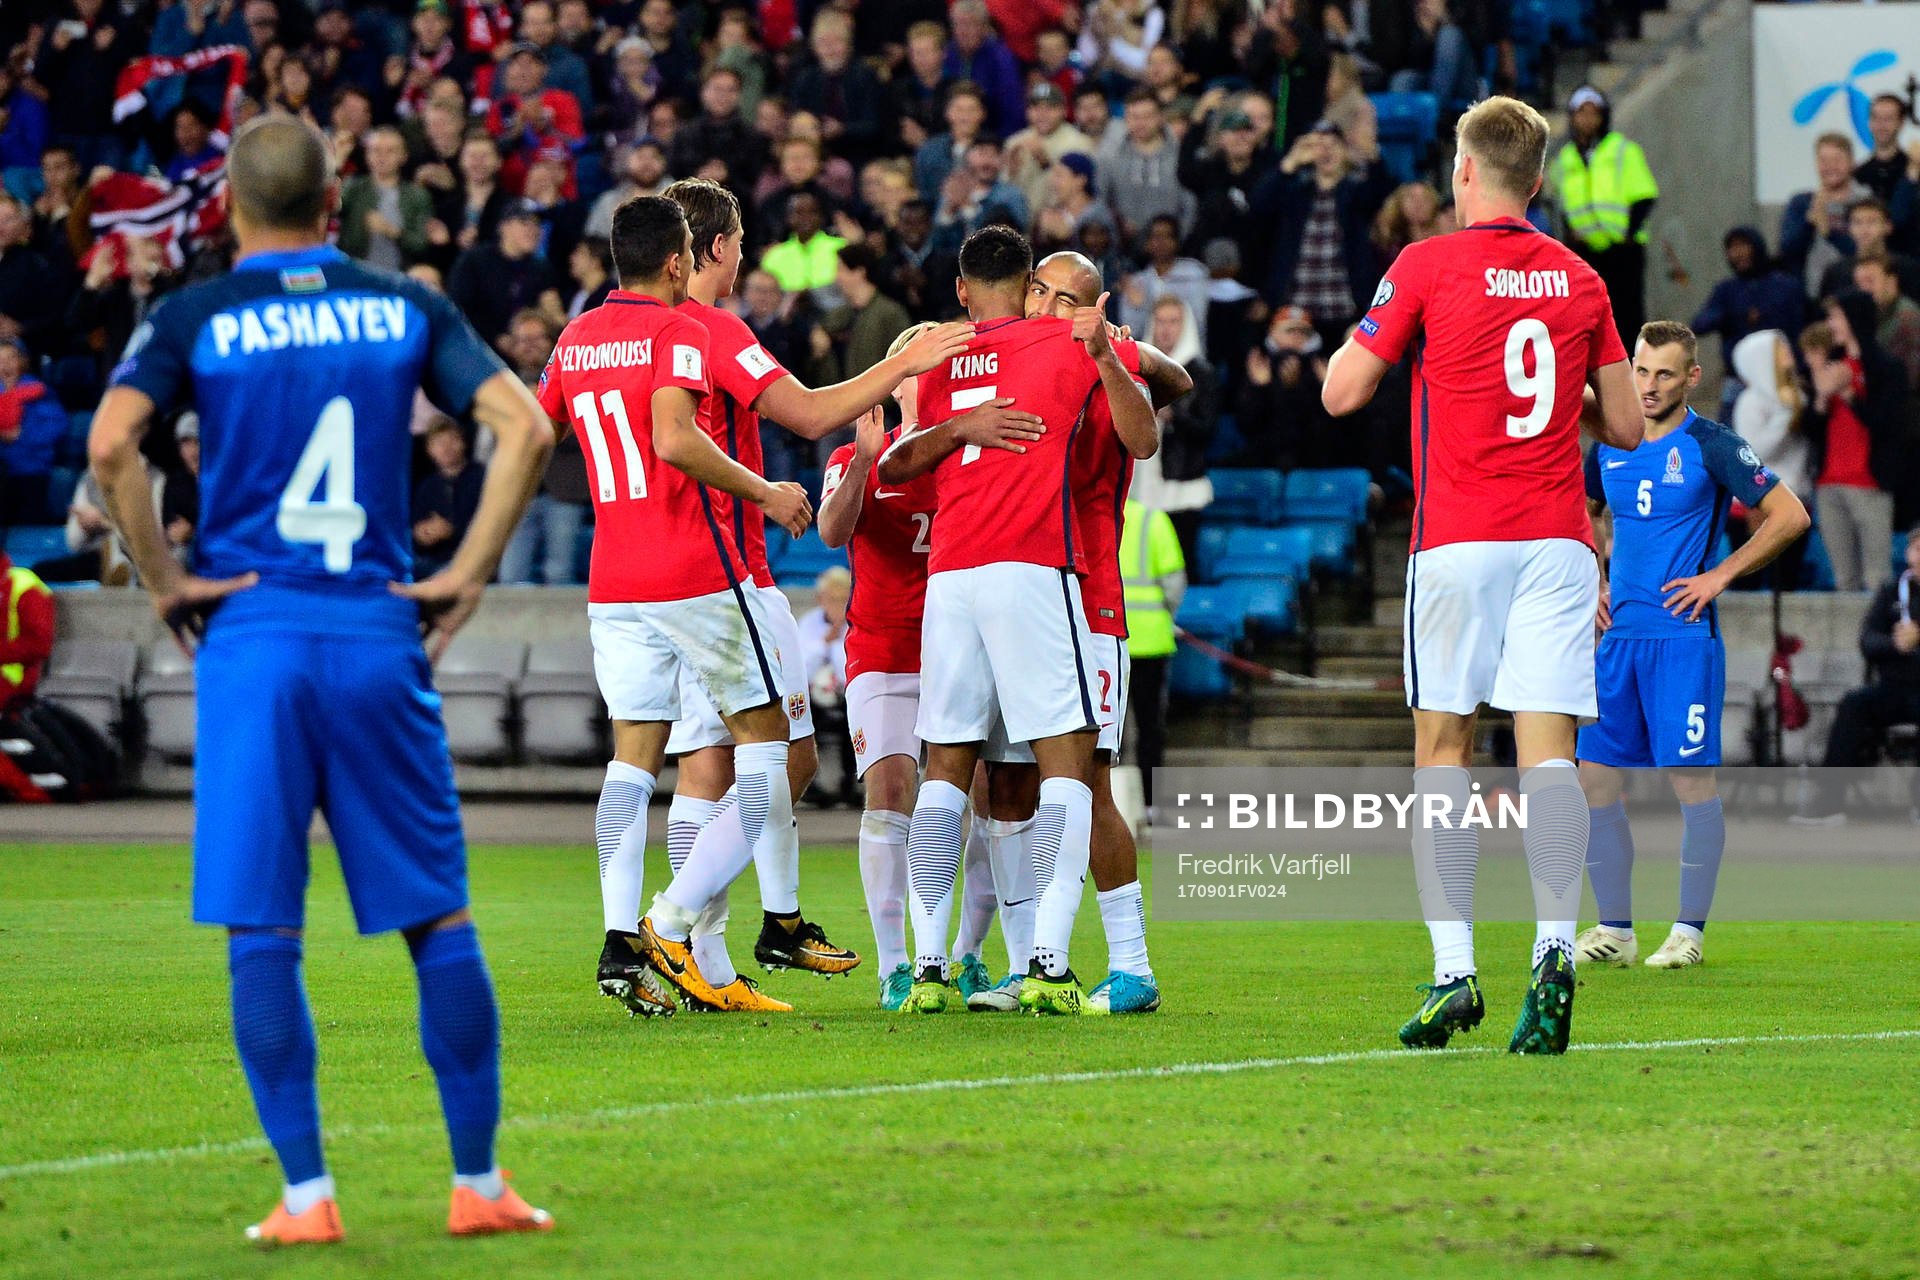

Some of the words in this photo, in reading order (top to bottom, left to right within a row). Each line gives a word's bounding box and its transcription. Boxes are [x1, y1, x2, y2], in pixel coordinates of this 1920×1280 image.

[1485, 268, 1569, 298] SØRLOTH
[211, 296, 406, 357] PASHAYEV
[951, 353, 998, 379] KING
[1504, 319, 1555, 438] 9
[573, 390, 647, 503] 11
[276, 396, 367, 574] 4
[1637, 480, 1653, 516] 5
[1687, 704, 1705, 743] 5
